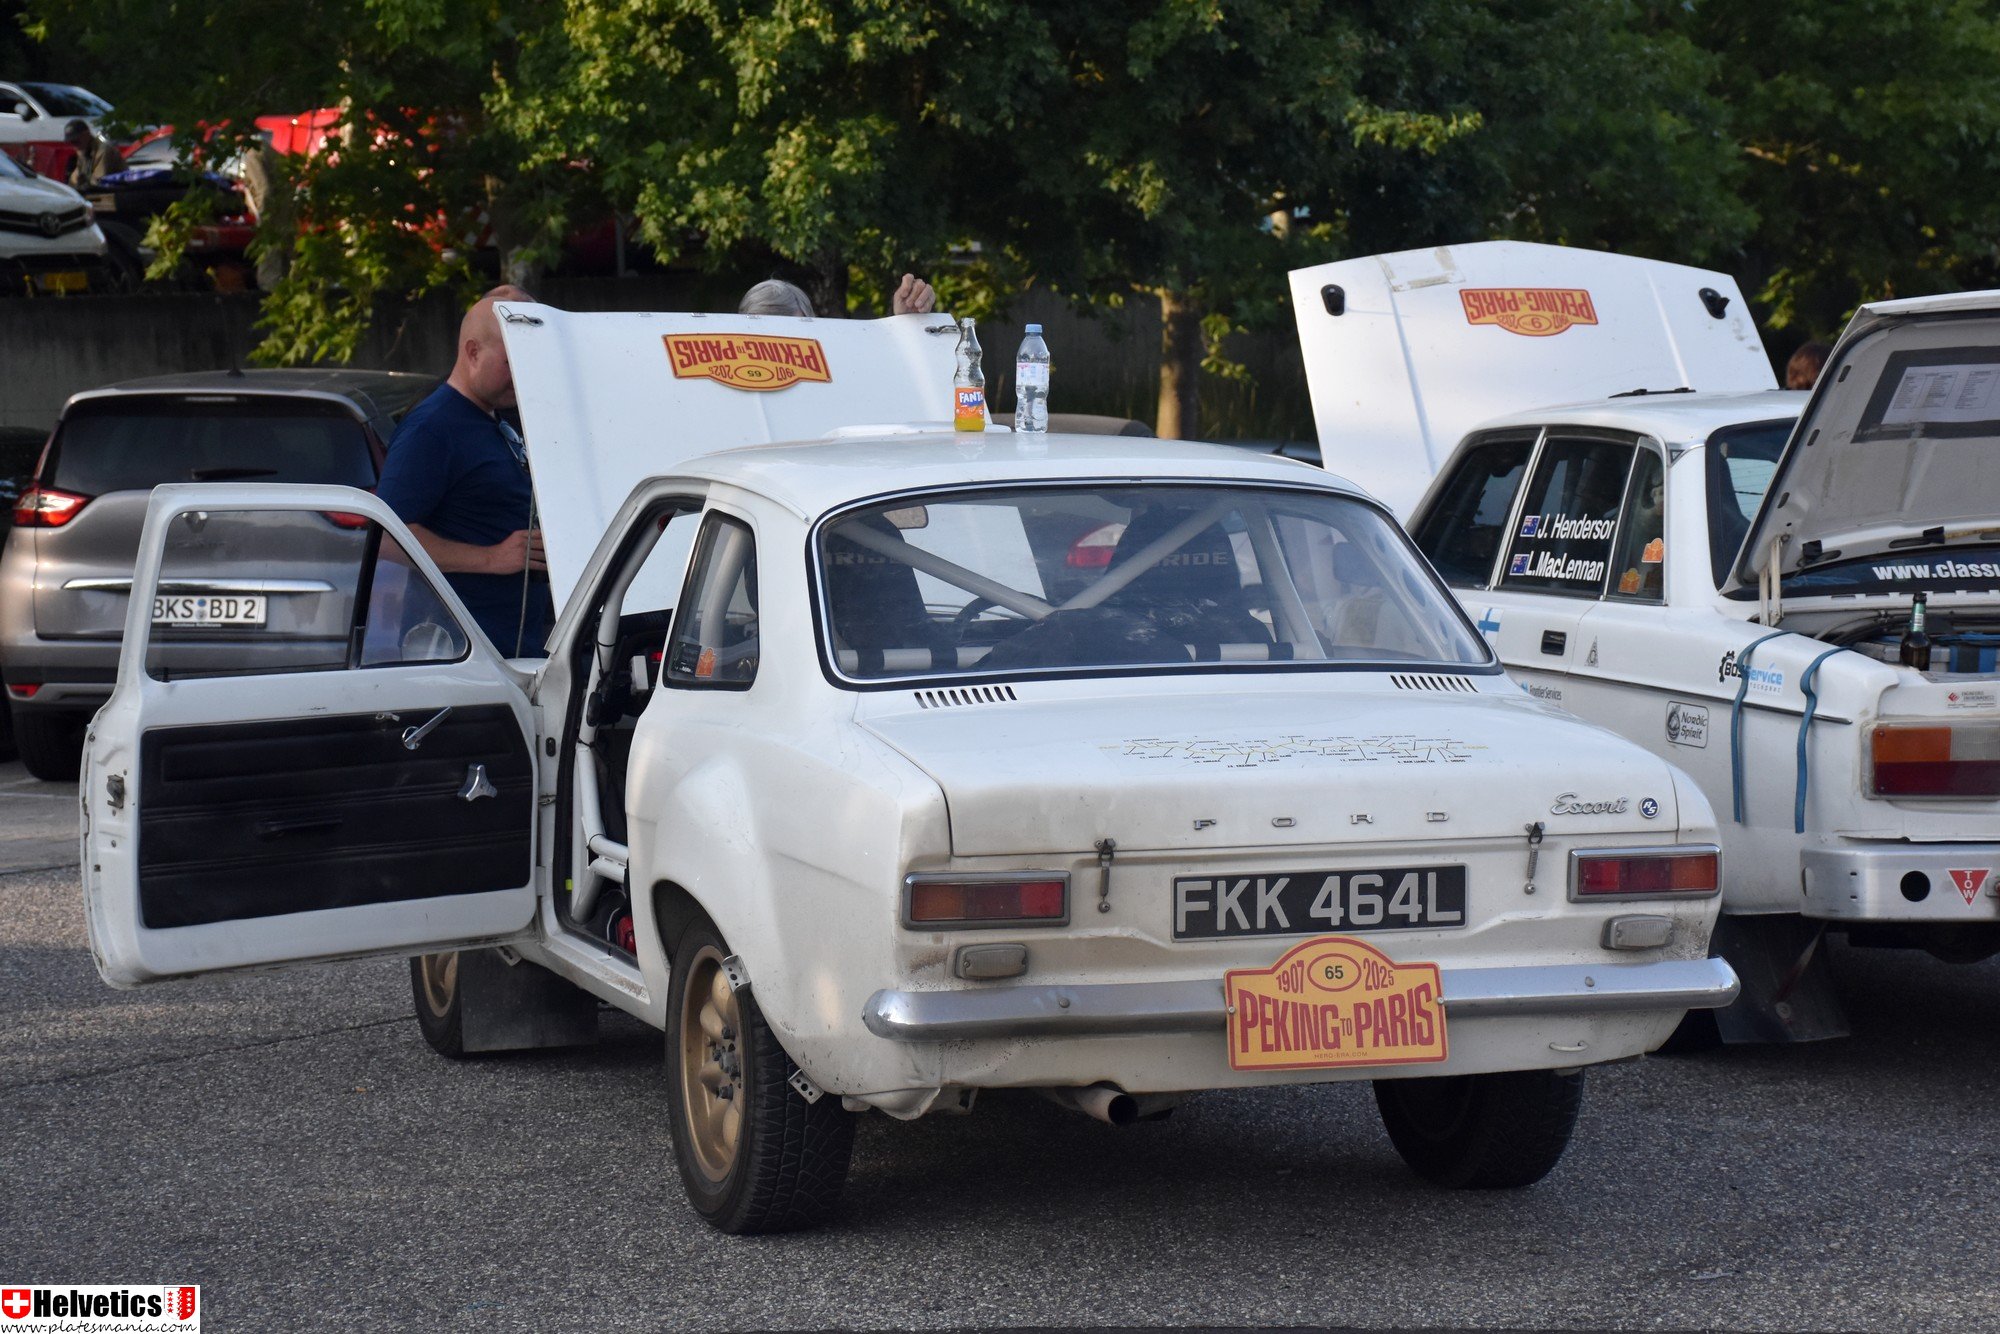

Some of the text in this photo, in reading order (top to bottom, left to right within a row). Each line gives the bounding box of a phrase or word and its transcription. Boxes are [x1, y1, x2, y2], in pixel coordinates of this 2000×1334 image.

[1465, 292, 1520, 320] PARIS
[1525, 292, 1593, 320] PEKING
[674, 340, 737, 368] PARIS
[744, 342, 821, 373] PEKING
[709, 365, 733, 379] 2025
[775, 366, 796, 381] 1907
[1537, 514, 1550, 538] J.
[1158, 552, 1229, 567] RIDE
[153, 599, 256, 618] BKS BD 2
[1681, 712, 1707, 726] Nordic
[1680, 725, 1703, 741] Spirit
[1551, 792, 1629, 815] Escort
[1193, 811, 1449, 830] FORD
[1963, 871, 1974, 898] TOW
[1176, 871, 1462, 933] FKK 464L
[1276, 958, 1395, 993] 1907 65 2025
[1238, 983, 1435, 1053] PEKING TO PARIS
